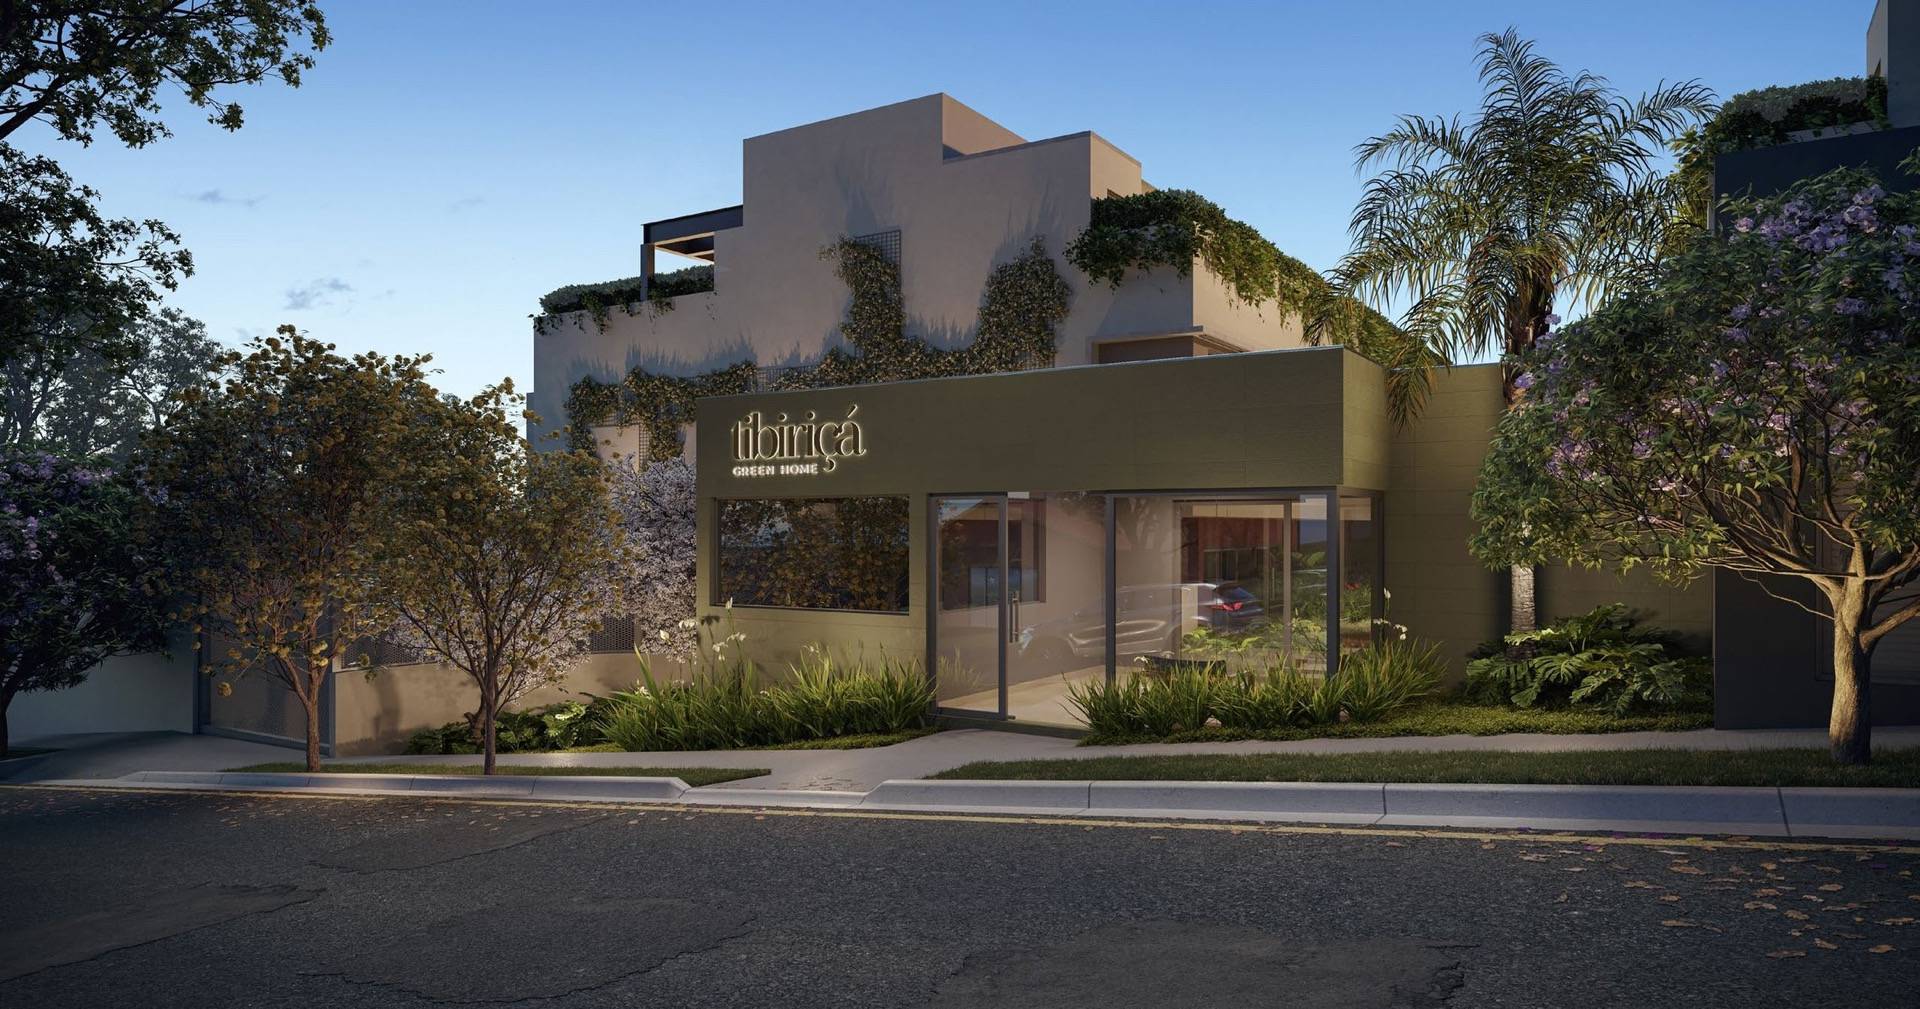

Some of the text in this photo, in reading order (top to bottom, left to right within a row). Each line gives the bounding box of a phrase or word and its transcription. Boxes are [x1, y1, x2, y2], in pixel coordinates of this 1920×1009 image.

[731, 404, 866, 472] tibiriçá
[732, 463, 819, 477] GREEN HOME
